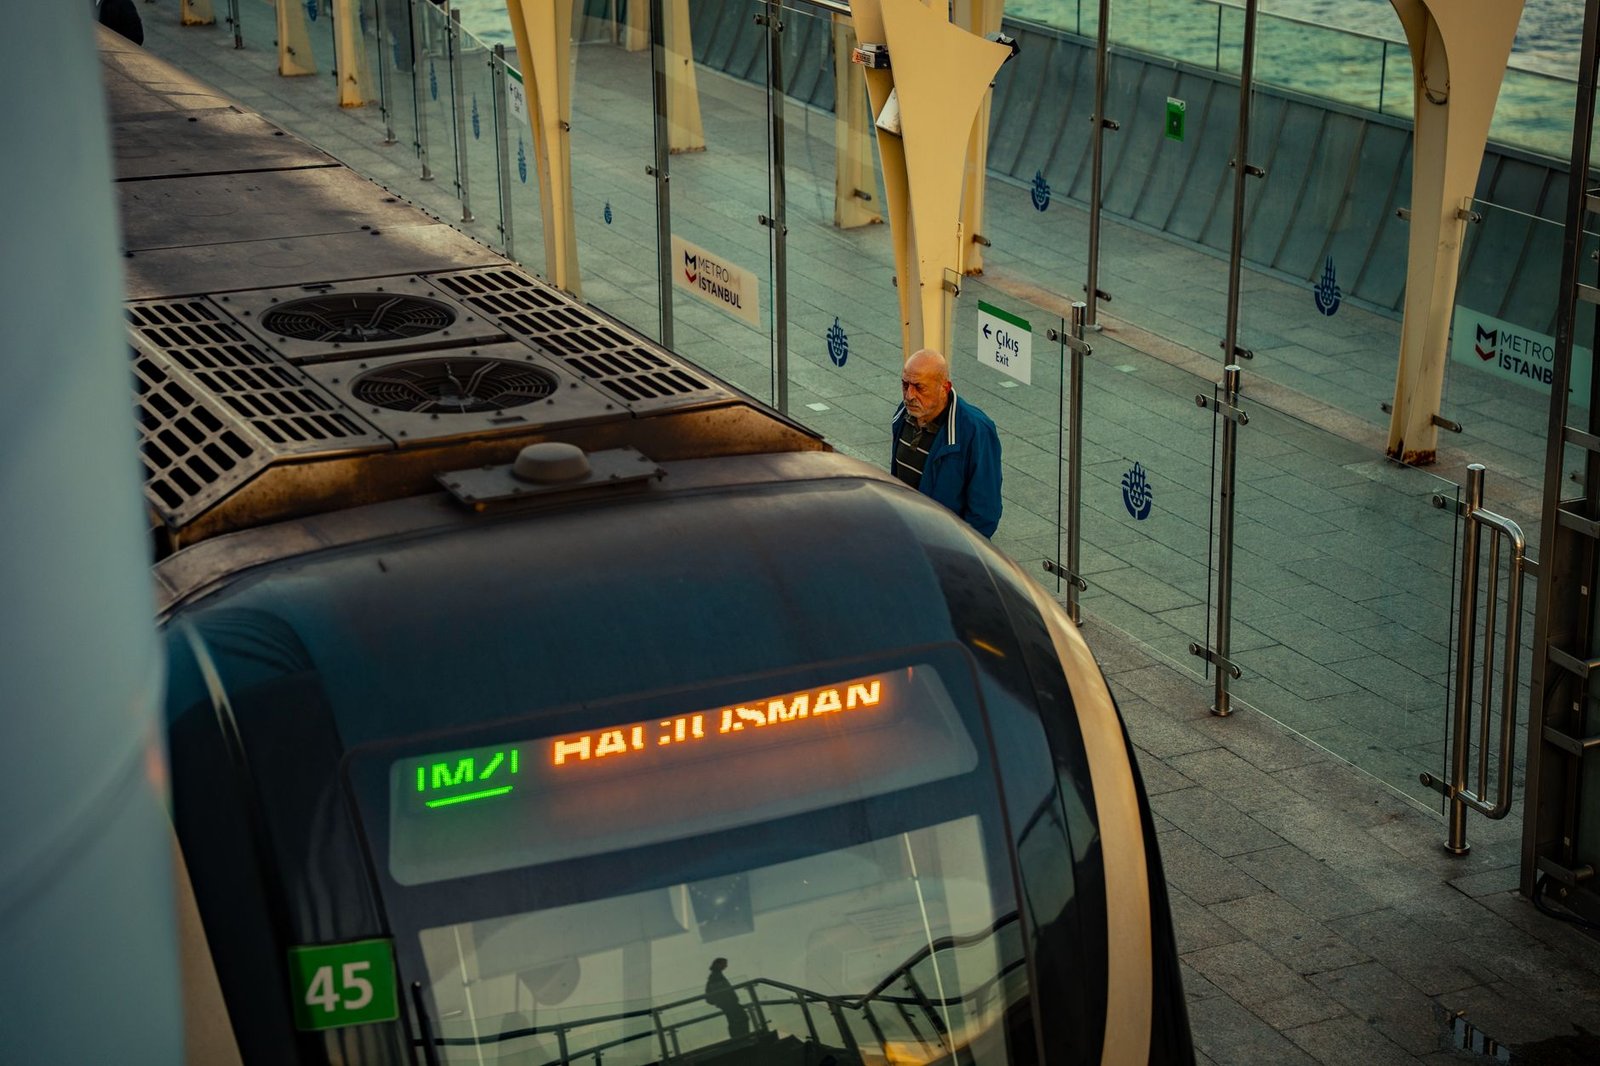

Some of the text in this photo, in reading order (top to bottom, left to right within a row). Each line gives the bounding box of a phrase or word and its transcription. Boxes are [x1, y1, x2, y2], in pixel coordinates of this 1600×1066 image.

[698, 256, 730, 283] METRO
[698, 273, 742, 309] İSTANBUL
[995, 351, 1009, 367] Exit
[996, 329, 1019, 357] Çıkış
[1500, 331, 1554, 363] METRO
[1498, 349, 1573, 392] İSTANB
[305, 961, 373, 1013] 45
